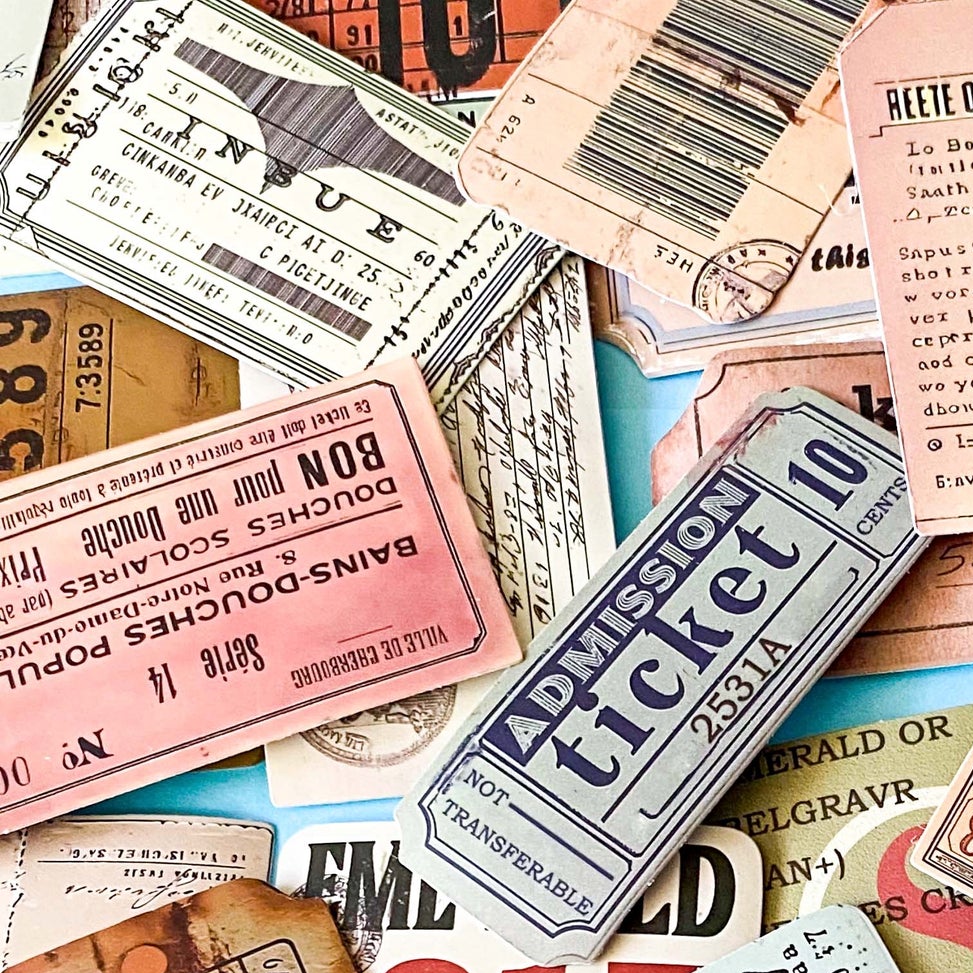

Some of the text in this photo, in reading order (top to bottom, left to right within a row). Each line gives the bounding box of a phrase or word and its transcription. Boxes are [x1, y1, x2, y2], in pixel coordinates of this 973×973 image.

[232, 458, 287, 500] pour
[301, 430, 388, 491] BON
[787, 437, 869, 511] 10
[80, 505, 167, 559] Douche
[174, 487, 219, 525] une
[246, 475, 400, 539] DOUCHES
[59, 526, 231, 600] SCOLAIRES
[123, 533, 419, 648] BAINS-DOUCHES
[401, 623, 449, 658] VILLE
[500, 477, 752, 756] ADMISSION
[374, 639, 402, 662] DE
[552, 522, 802, 790] ticket
[690, 637, 793, 745] 2531A
[899, 715, 953, 746] OR
[463, 765, 510, 807] NOT
[442, 797, 595, 918] TRANSFERABLE
